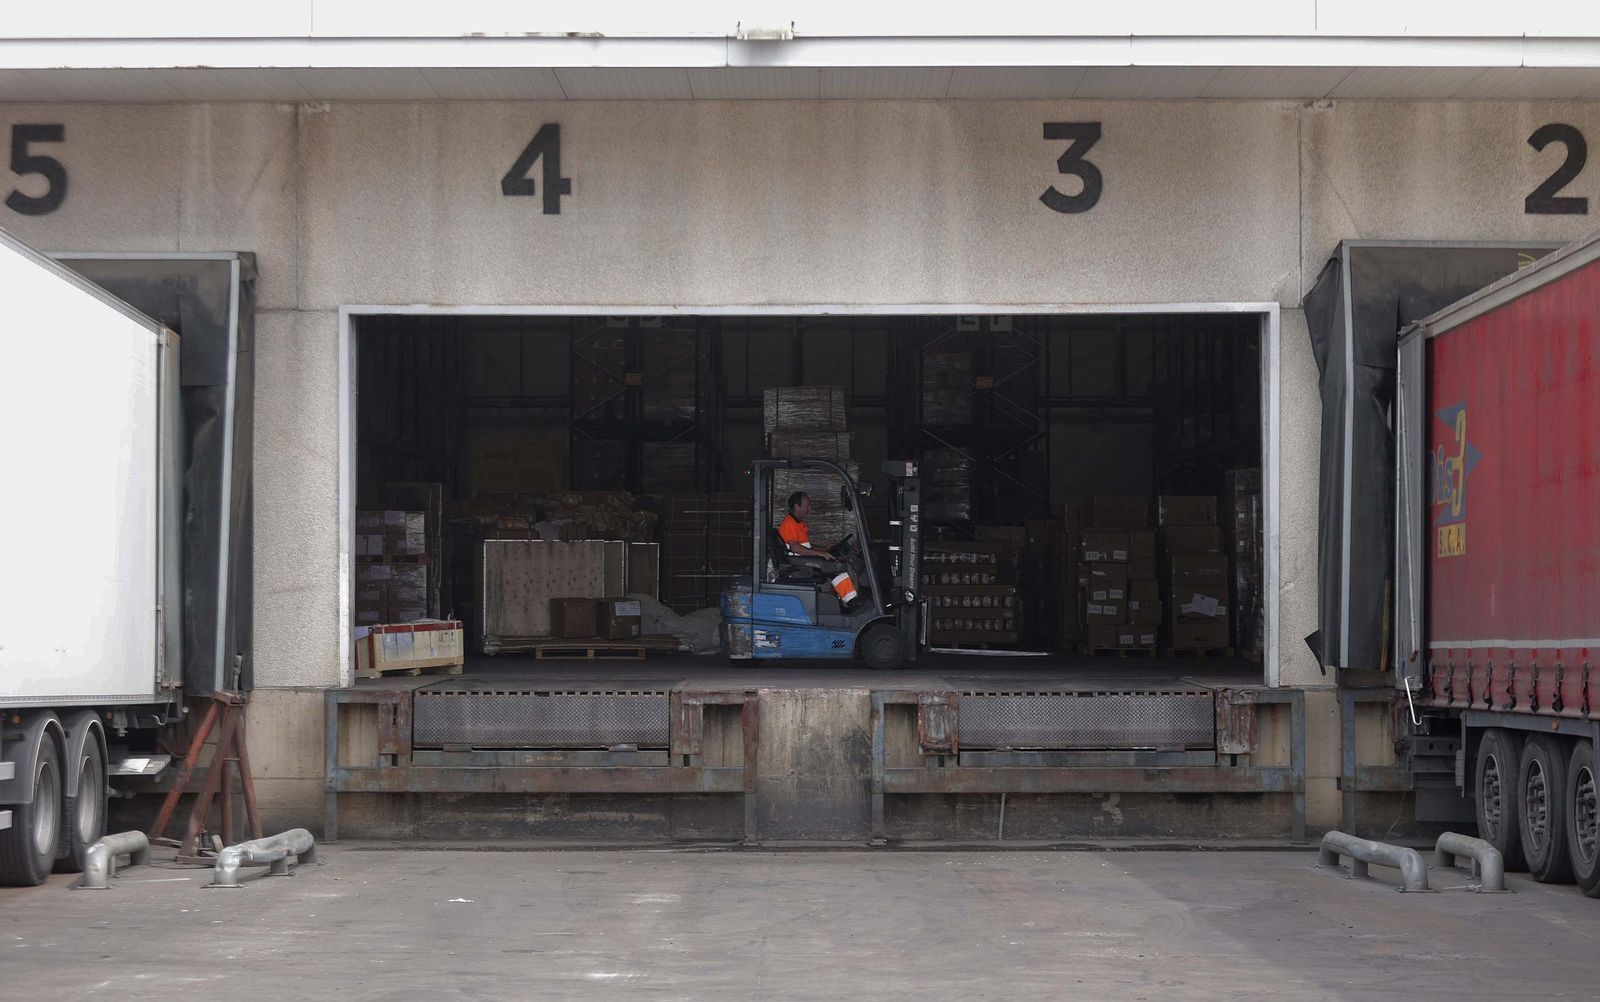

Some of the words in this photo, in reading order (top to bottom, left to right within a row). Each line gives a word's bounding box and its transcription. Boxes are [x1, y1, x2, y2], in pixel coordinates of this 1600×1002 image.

[5, 124, 68, 215] 5
[501, 124, 572, 215] 4
[1039, 122, 1103, 213] 3
[1525, 123, 1588, 215] 2
[910, 504, 919, 532] BYD
